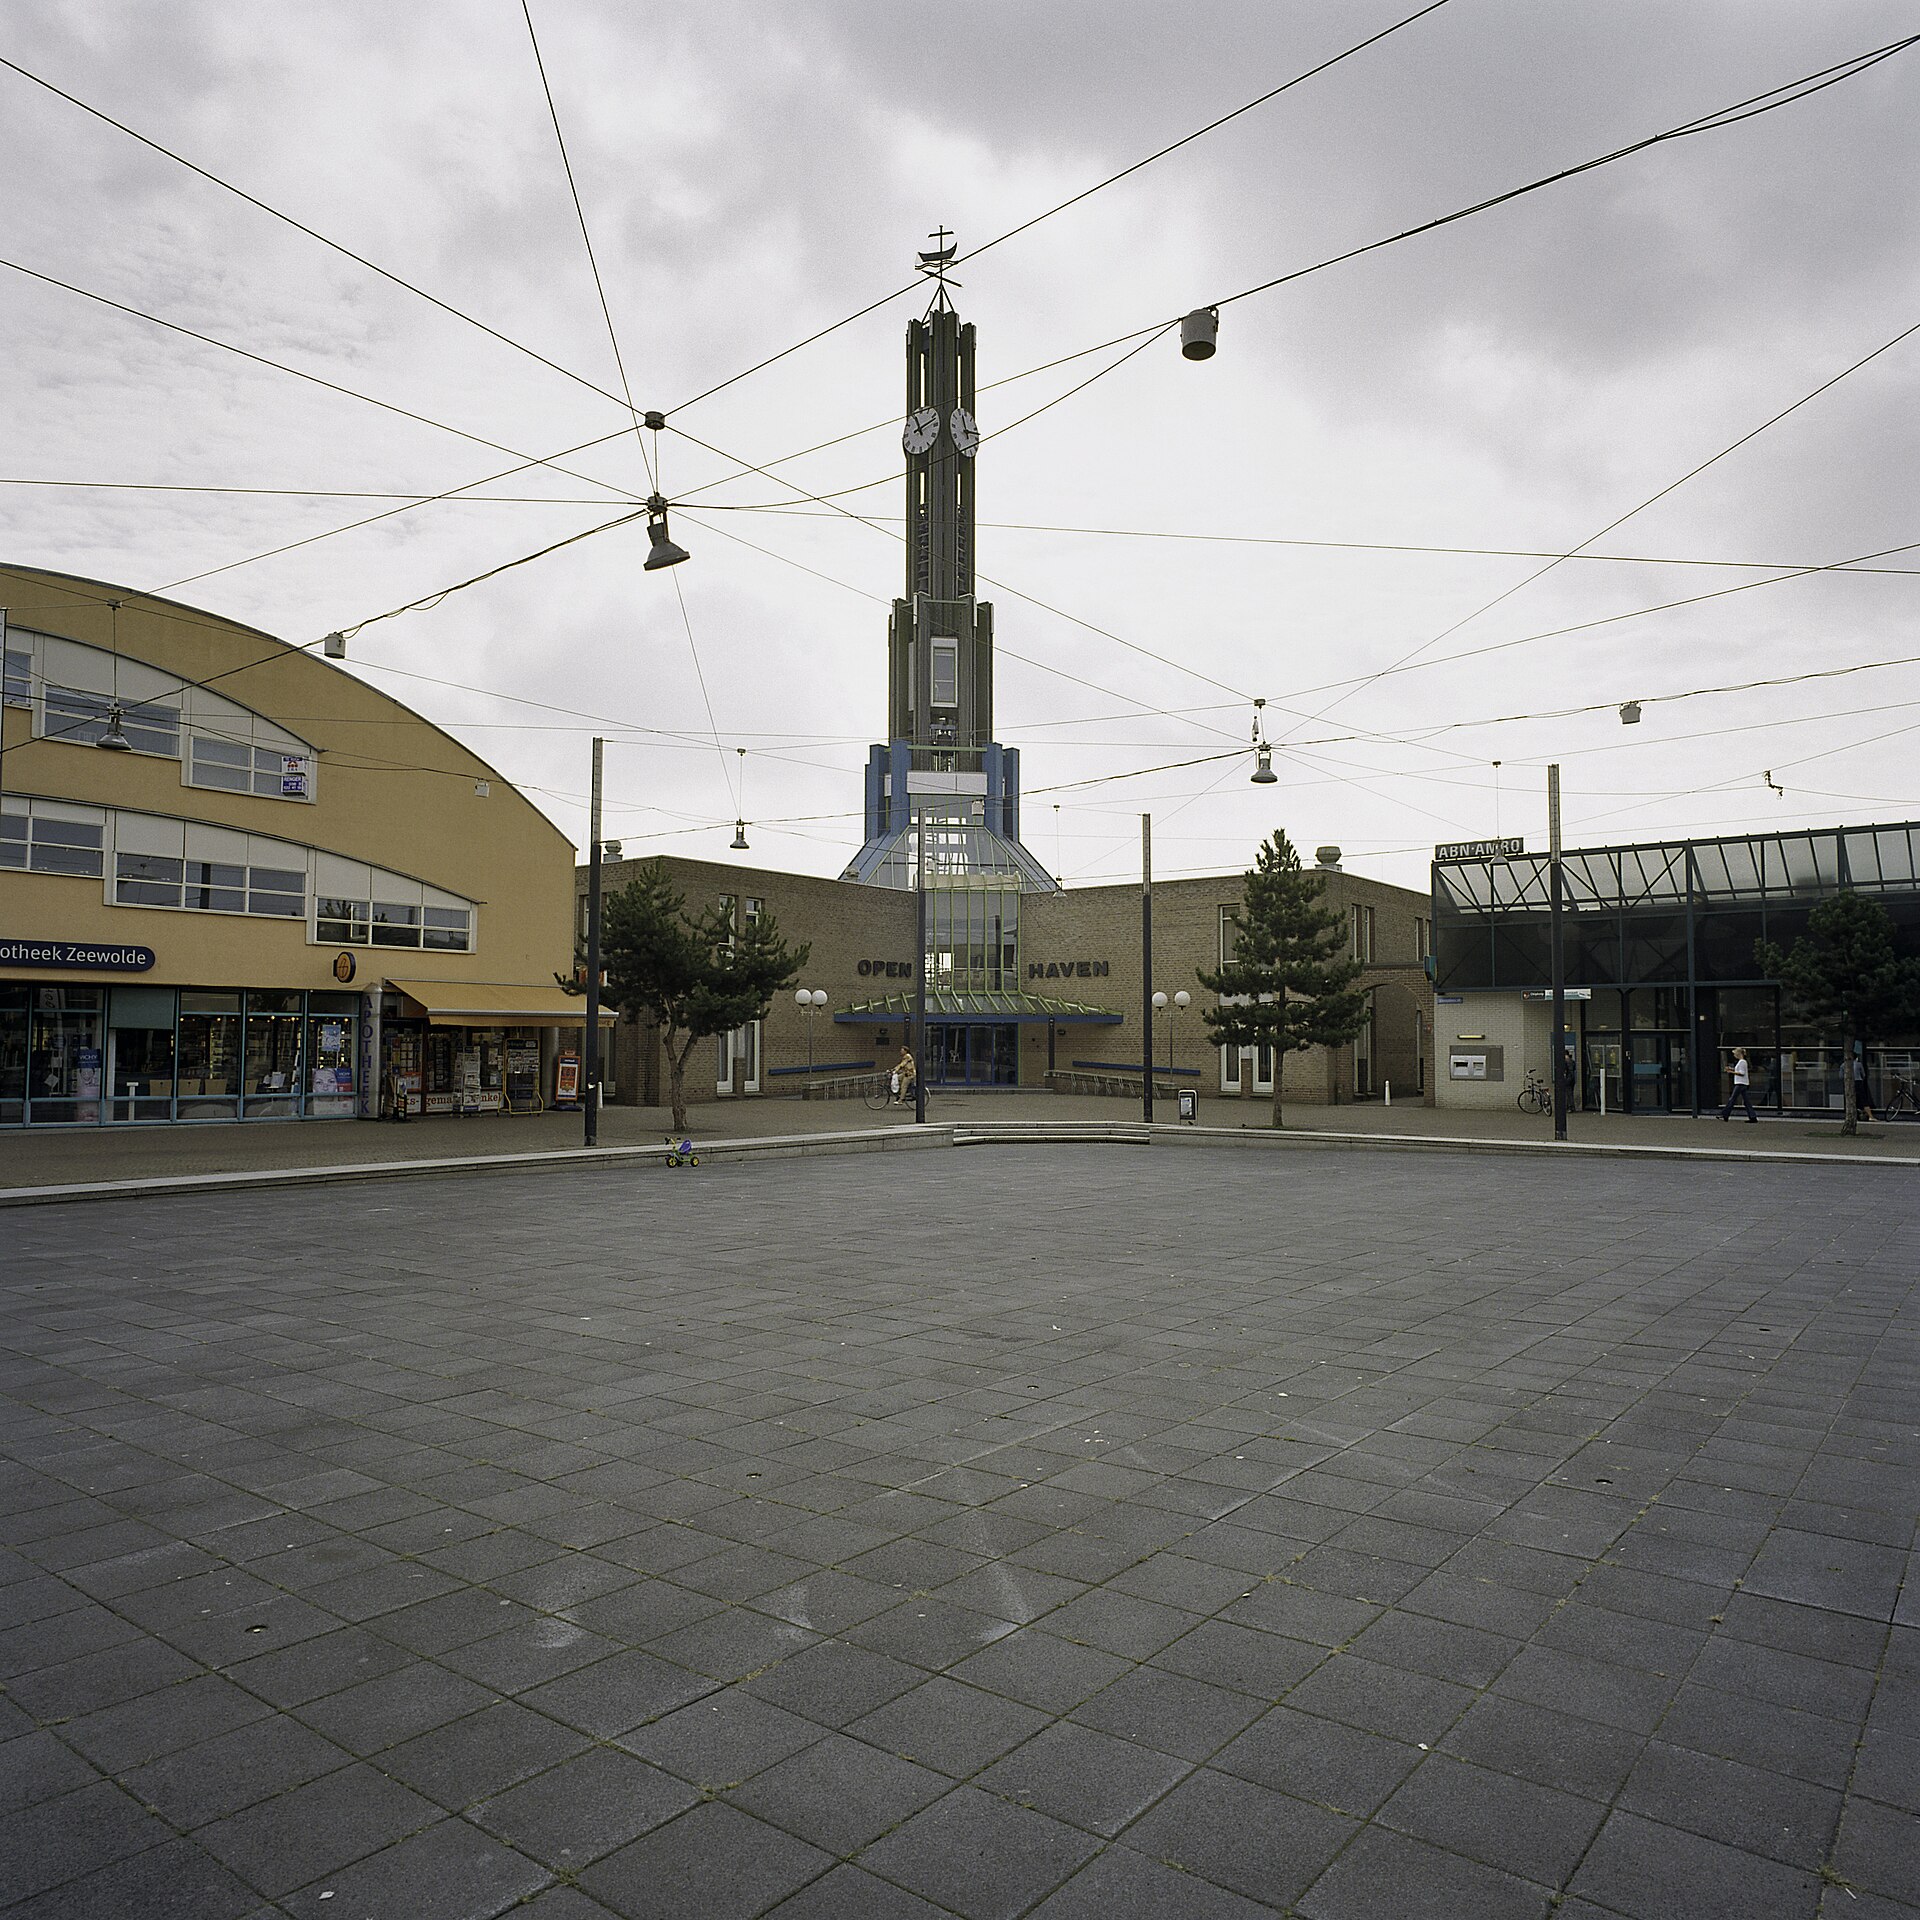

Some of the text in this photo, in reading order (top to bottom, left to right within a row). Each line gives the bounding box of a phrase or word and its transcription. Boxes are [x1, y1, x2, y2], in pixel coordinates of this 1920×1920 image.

[66, 947, 147, 965] Zeewolde
[857, 959, 912, 978] OPEN
[1028, 960, 1109, 979] HAVEN
[361, 995, 373, 1114] APOTHEEK
